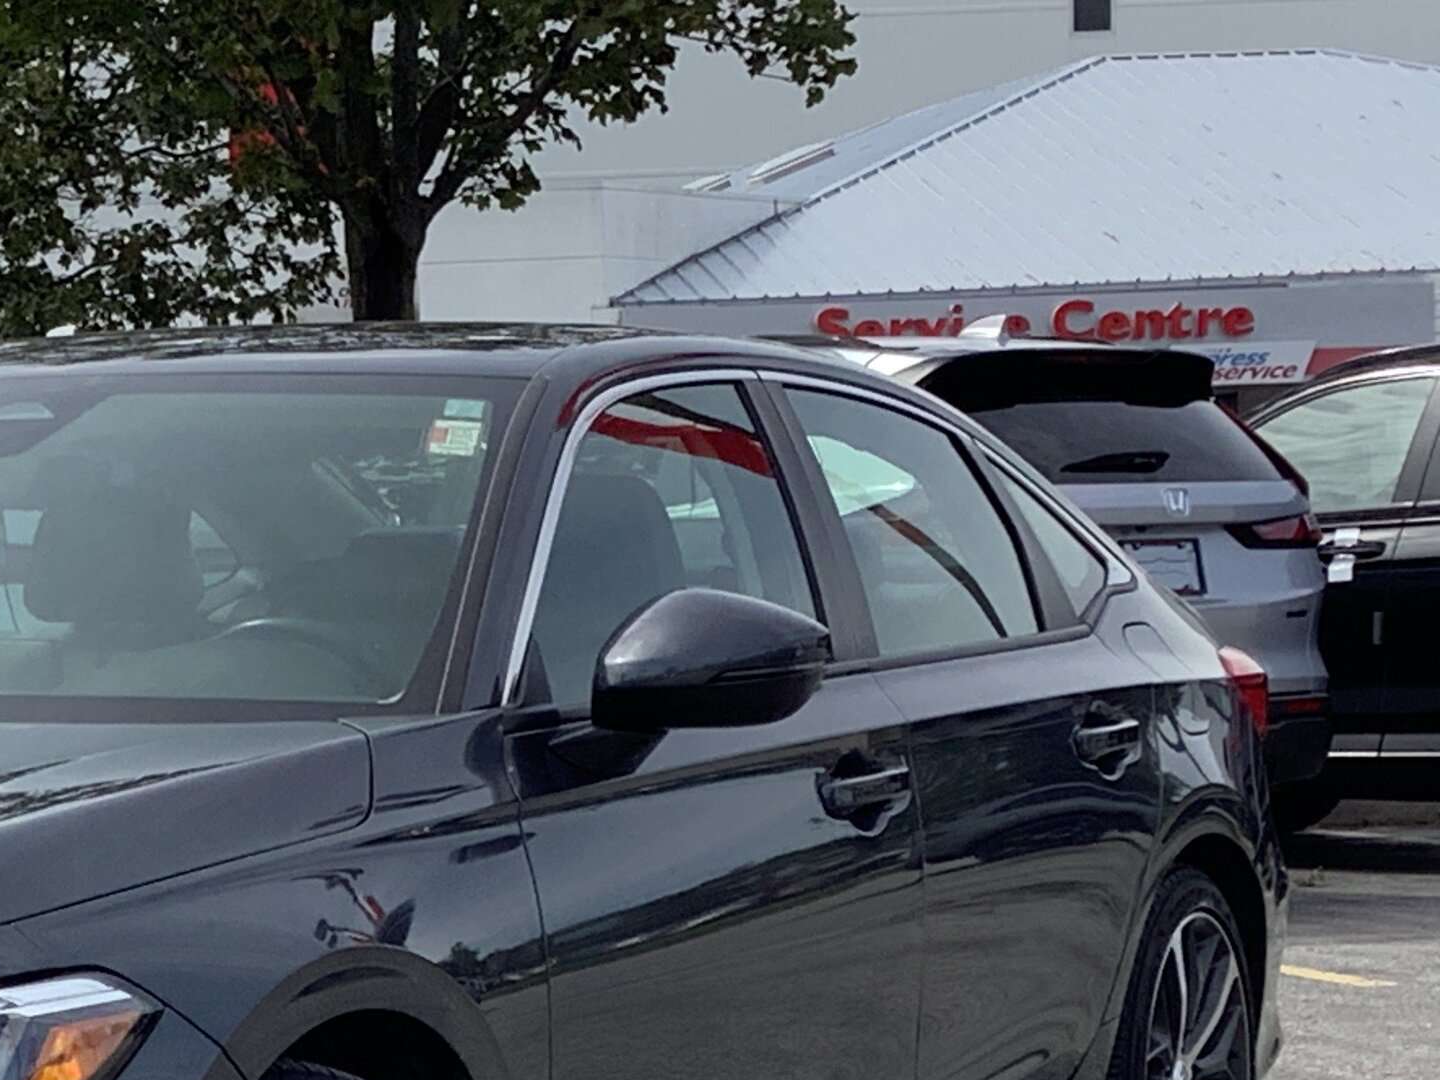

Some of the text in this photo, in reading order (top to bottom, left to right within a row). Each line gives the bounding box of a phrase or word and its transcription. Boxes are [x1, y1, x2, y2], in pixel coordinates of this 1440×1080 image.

[817, 300, 1255, 340] Servie Centre
[1214, 364, 1298, 381] service
